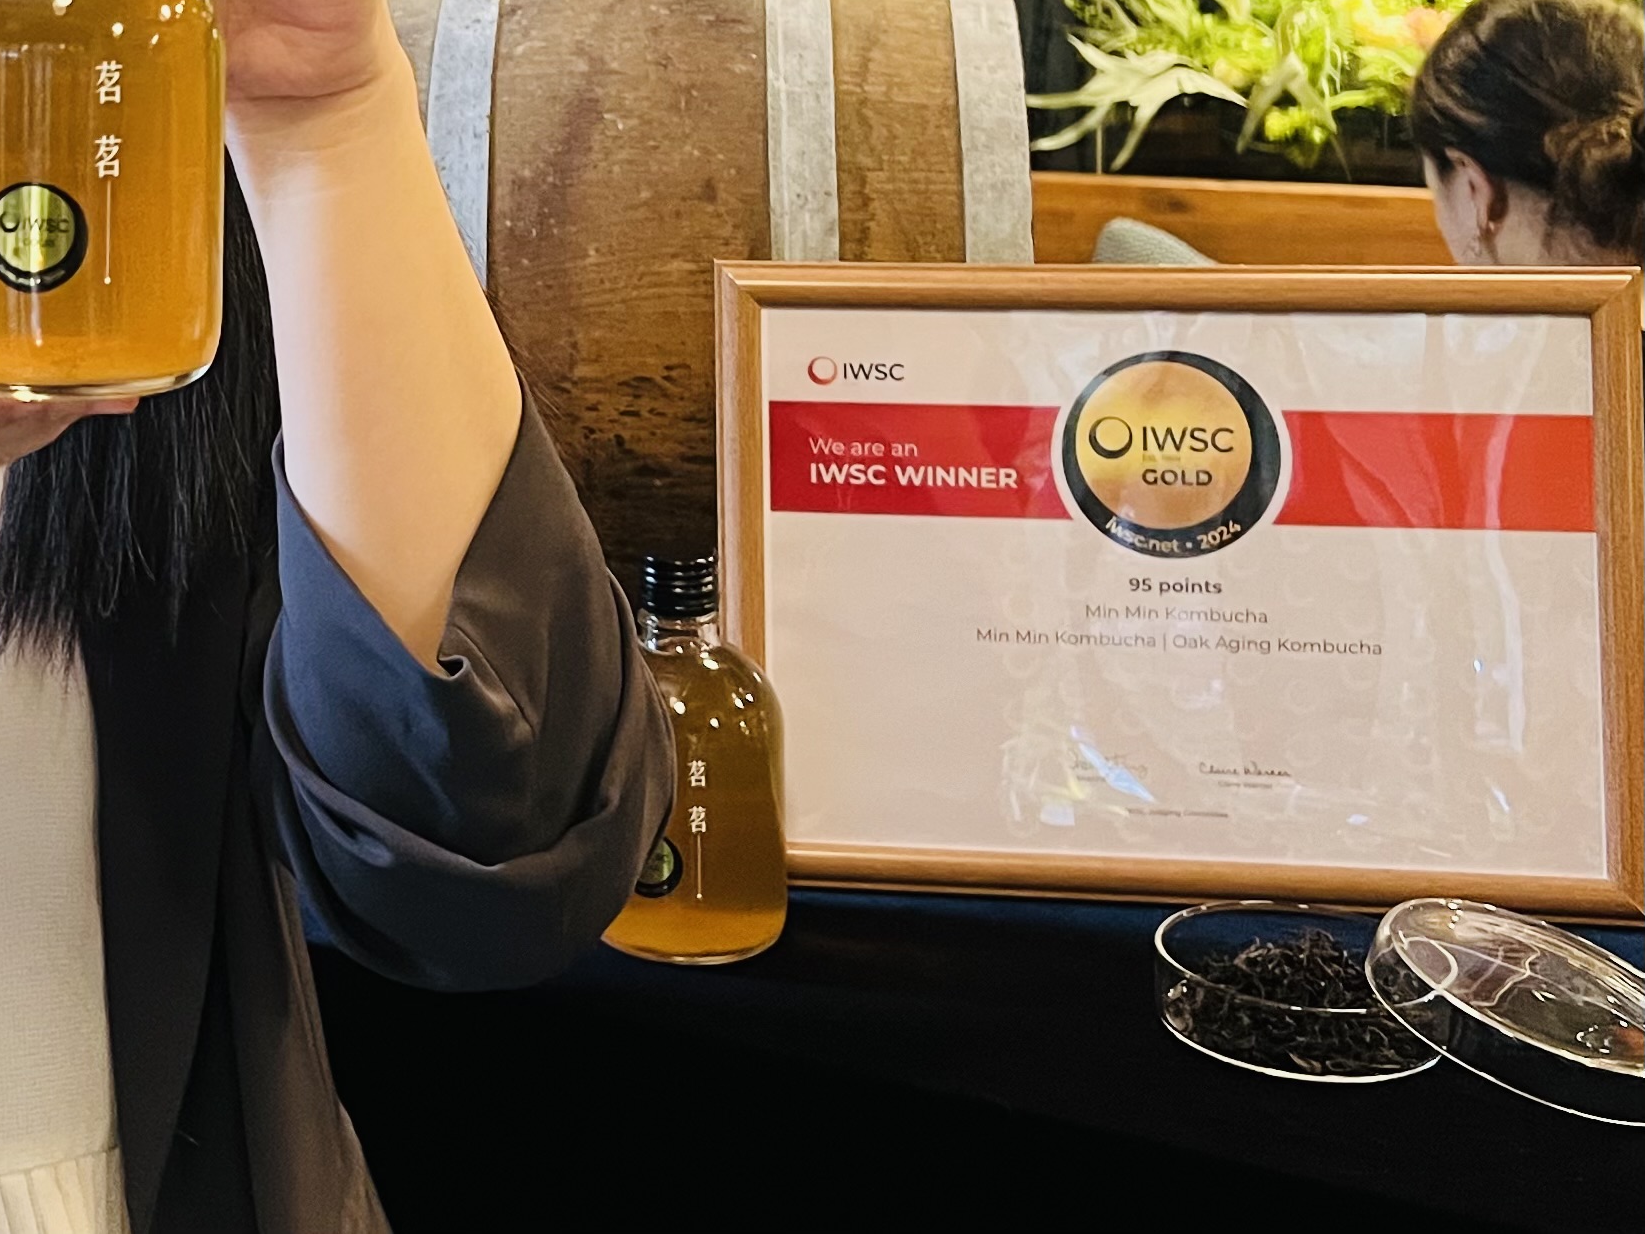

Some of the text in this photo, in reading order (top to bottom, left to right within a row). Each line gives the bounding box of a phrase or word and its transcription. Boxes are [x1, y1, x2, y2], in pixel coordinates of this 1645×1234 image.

[94, 59, 123, 179] 茗茗
[842, 362, 905, 381] IWSC
[808, 437, 918, 457] We are an
[1141, 425, 1235, 453] IWSC
[810, 462, 1018, 489] IWSC WINNER
[1141, 468, 1213, 487] GOLD
[1196, 520, 1242, 550] 2024
[1128, 577, 1222, 596] 95 points
[1085, 604, 1268, 624] Min Min Kombucha
[976, 628, 1010, 644] Min
[1015, 629, 1049, 645] Min
[1055, 631, 1157, 648] Kombucha
[1172, 635, 1211, 650] Oak
[1215, 636, 1271, 655] Aging
[1277, 637, 1383, 655] Kombucha
